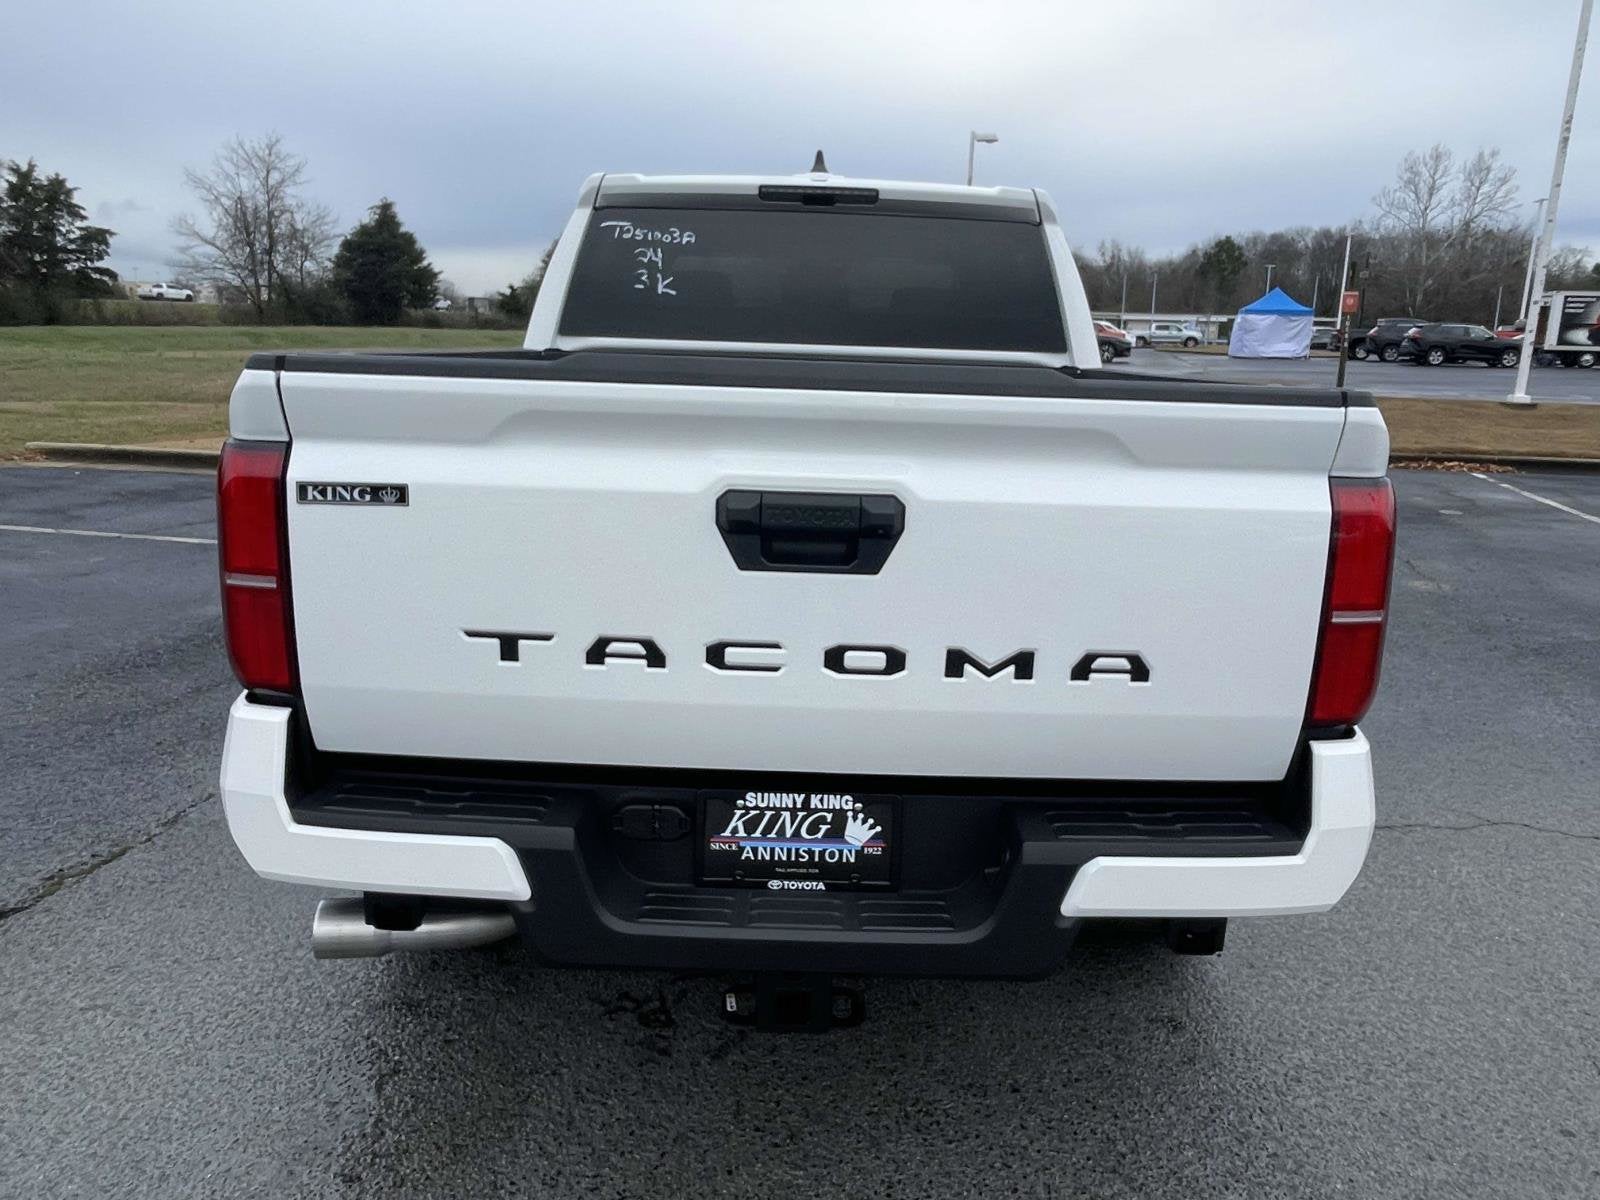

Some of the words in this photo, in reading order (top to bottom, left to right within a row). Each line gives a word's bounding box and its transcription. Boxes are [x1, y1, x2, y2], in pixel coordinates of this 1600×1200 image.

[634, 248, 662, 270] 24
[307, 485, 371, 502] KING
[461, 630, 1150, 684] TACOMA
[745, 792, 805, 809] SUNNY
[810, 794, 854, 810] KING
[720, 809, 833, 839] KING
[710, 842, 738, 851] SINCE
[741, 847, 856, 863] ANNISTON
[863, 847, 882, 855] 1922
[783, 880, 826, 891] TOYOTA
